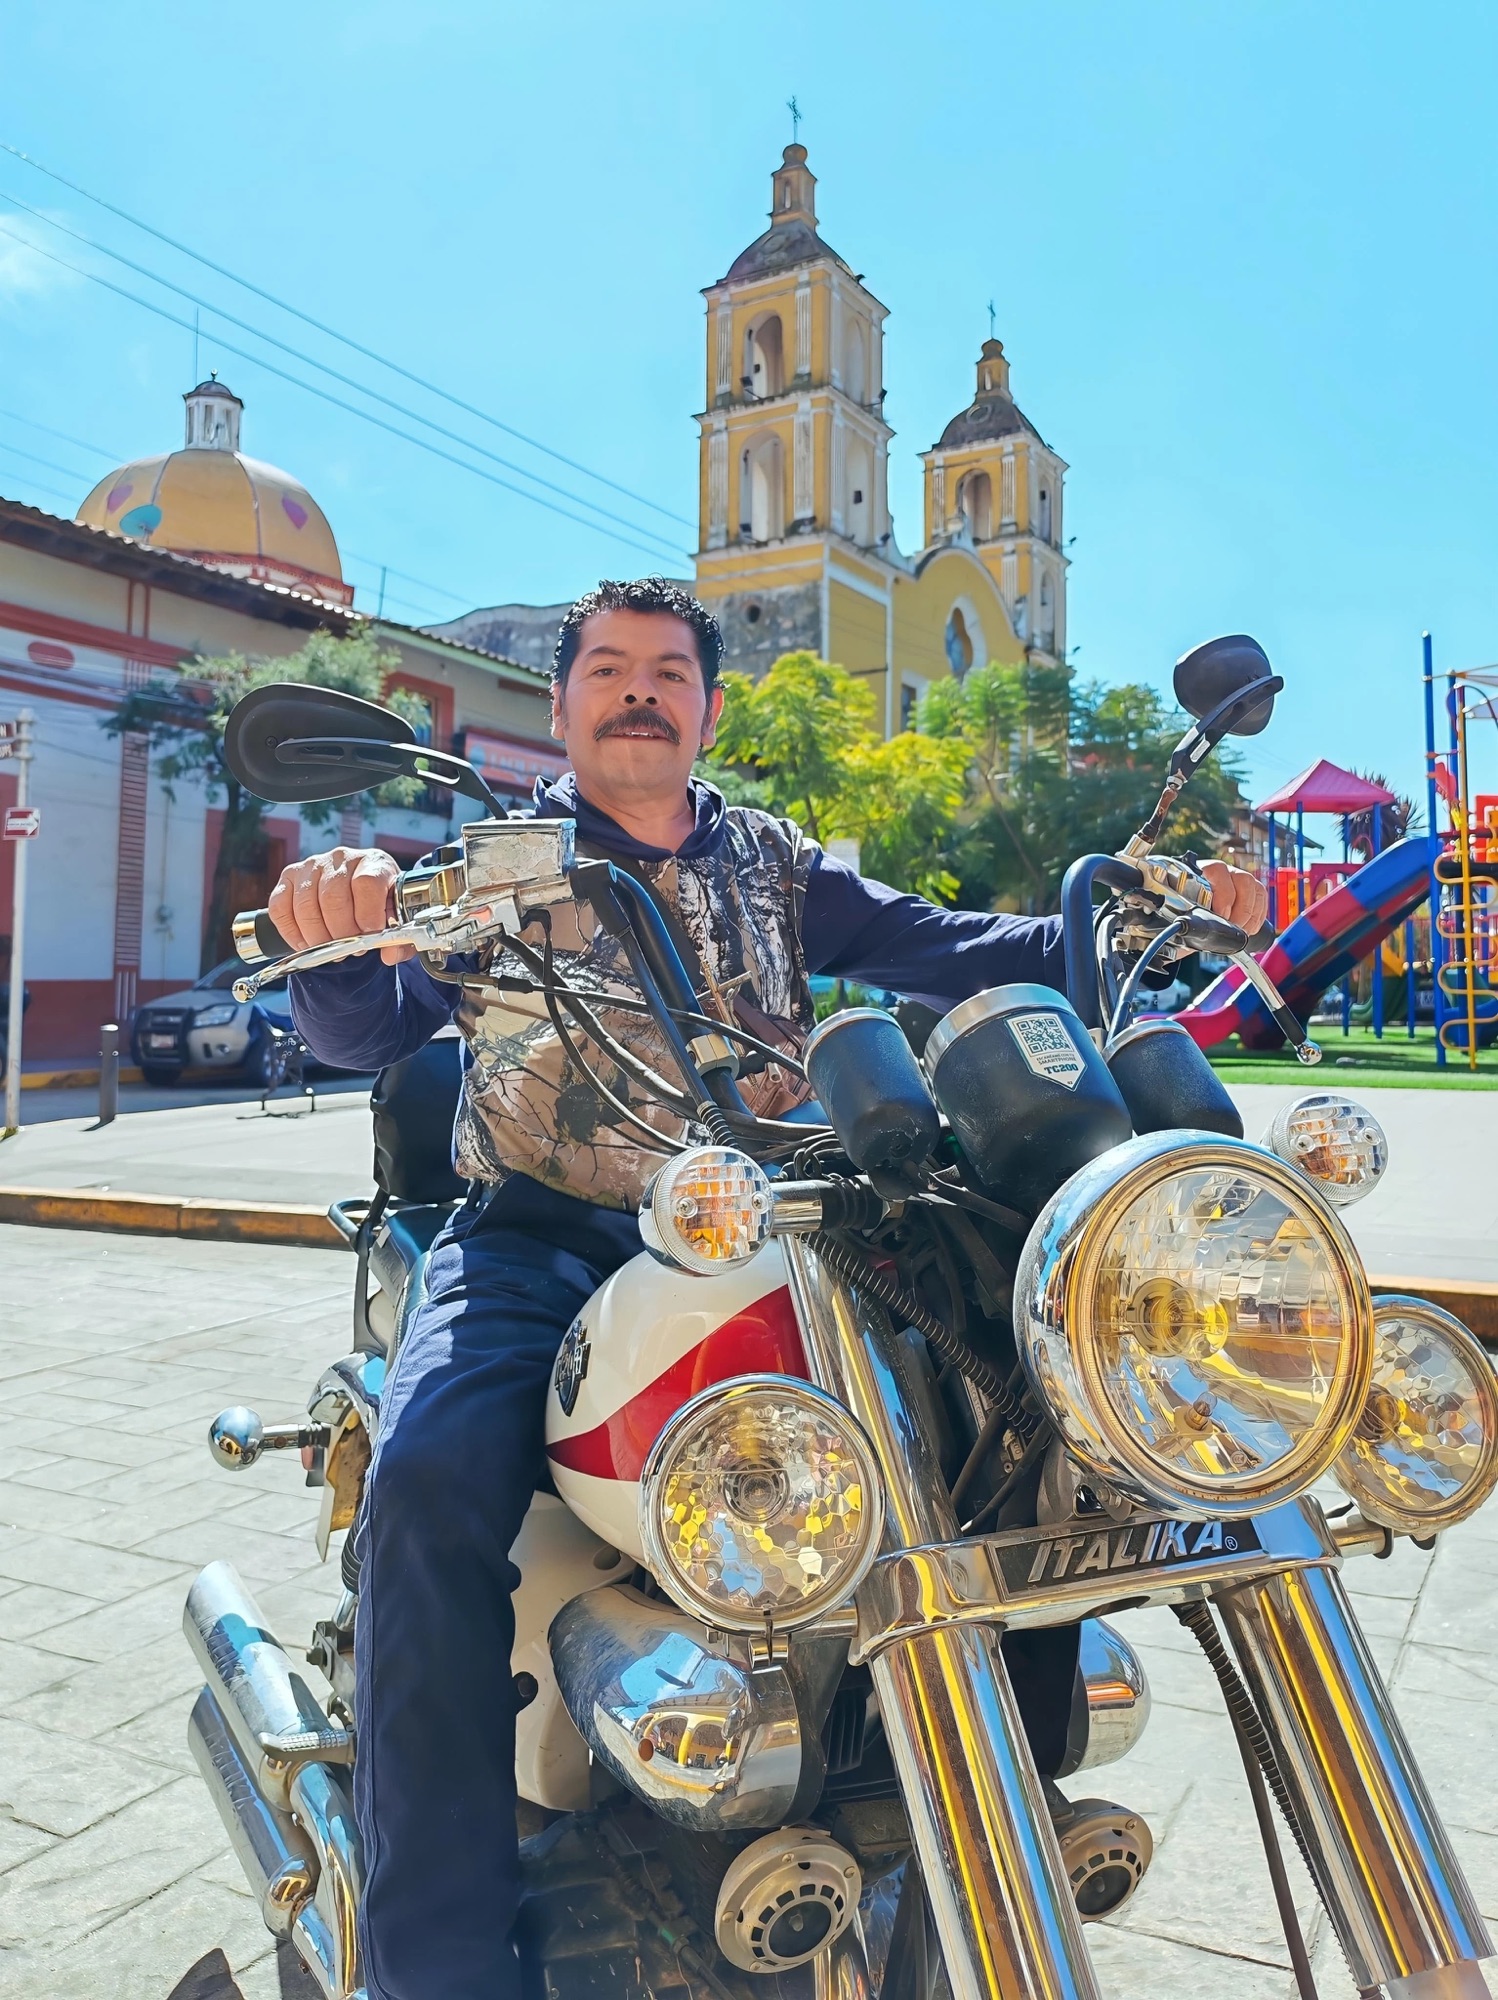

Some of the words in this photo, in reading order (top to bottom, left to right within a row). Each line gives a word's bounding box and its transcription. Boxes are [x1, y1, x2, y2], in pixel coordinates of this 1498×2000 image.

[1038, 1056, 1077, 1065] SMARTPHONE
[1044, 1063, 1079, 1075] TC200
[1027, 1521, 1223, 1583] ITALIKA
